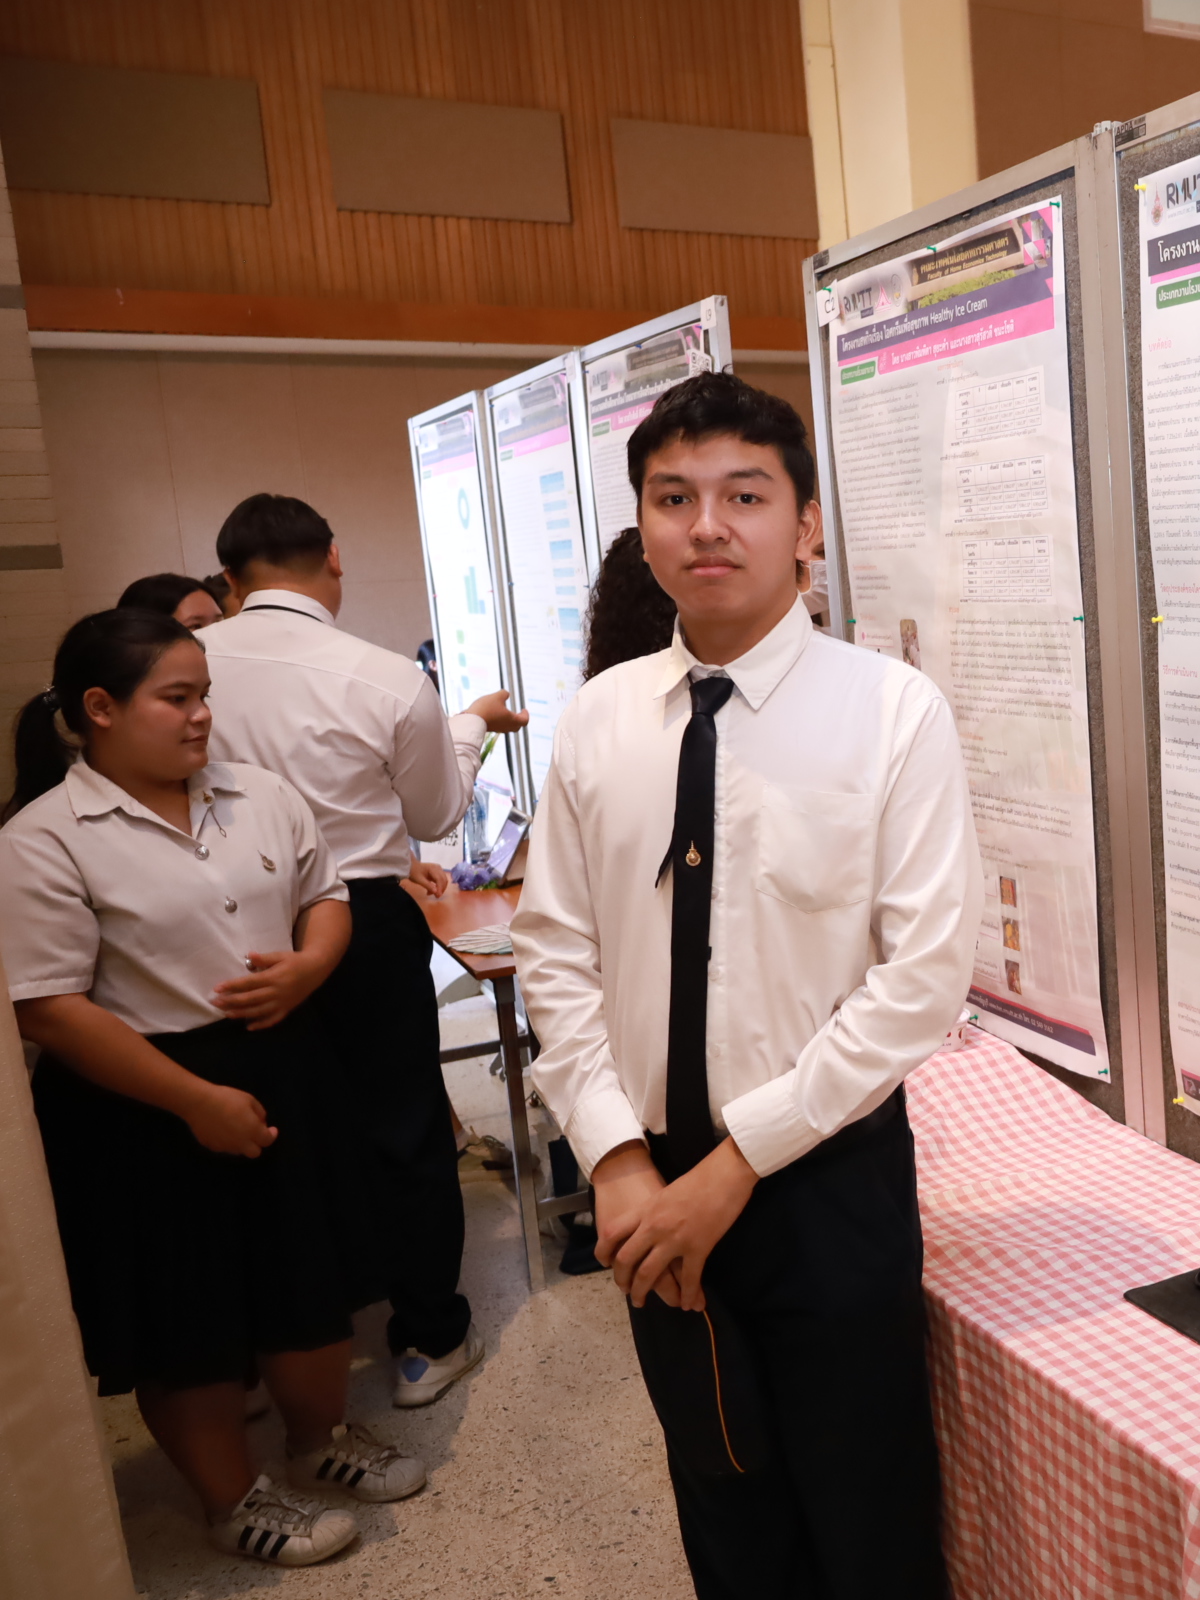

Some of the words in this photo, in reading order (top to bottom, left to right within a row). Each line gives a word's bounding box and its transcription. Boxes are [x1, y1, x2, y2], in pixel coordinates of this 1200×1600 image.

[824, 299, 836, 315] C2
[929, 307, 954, 327] Healthy
[955, 304, 965, 317] Ice
[966, 298, 988, 314] Cream
